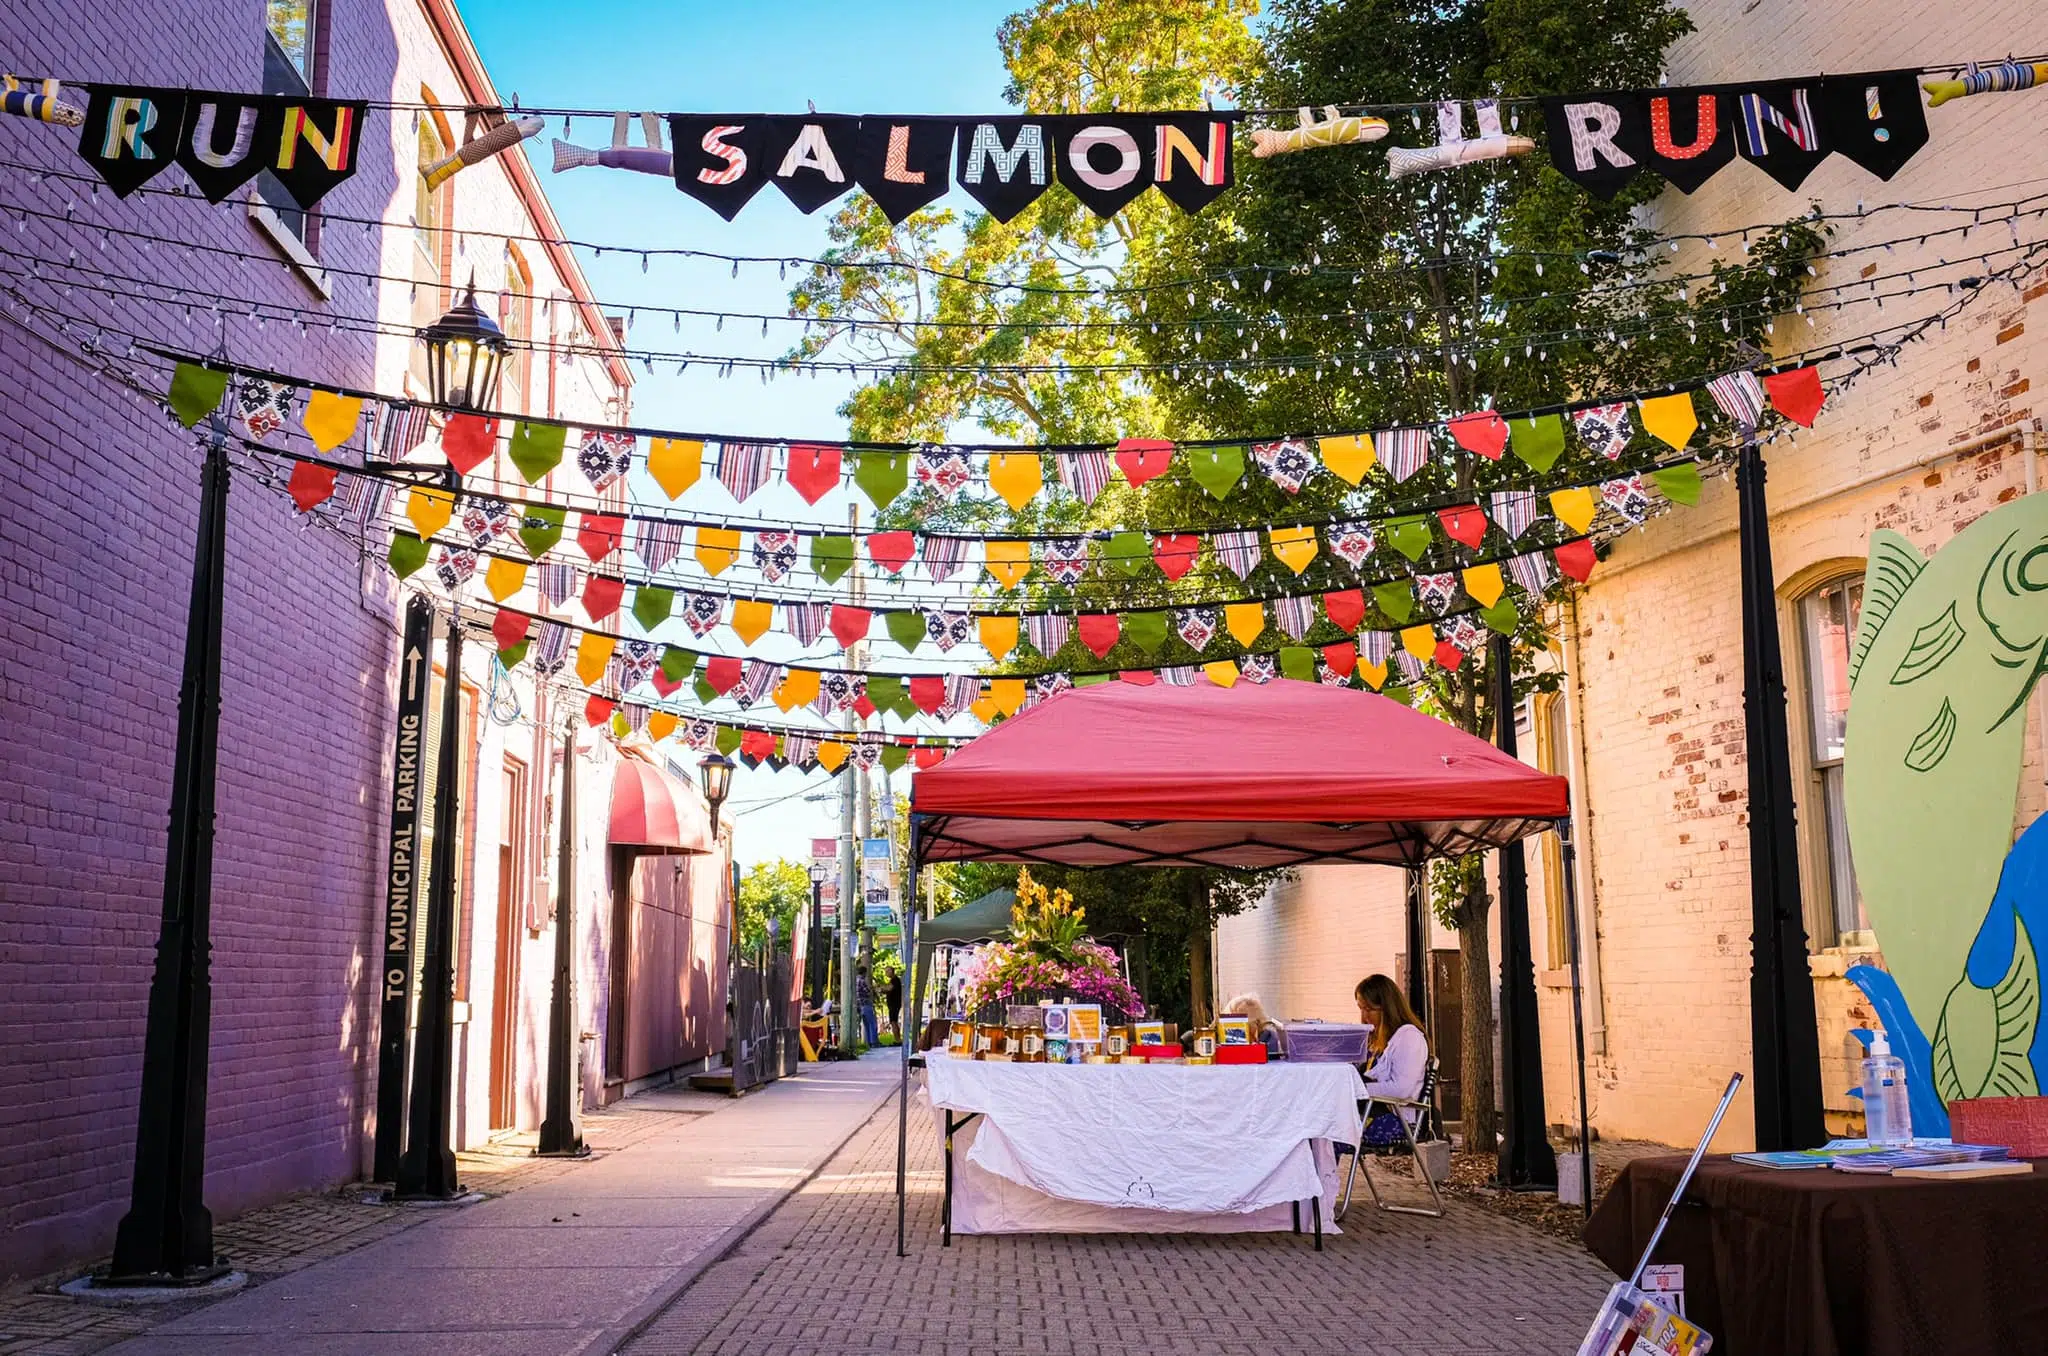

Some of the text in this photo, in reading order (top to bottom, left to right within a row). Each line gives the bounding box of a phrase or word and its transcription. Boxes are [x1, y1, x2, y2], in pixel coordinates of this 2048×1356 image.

[100, 86, 1890, 191] RUN SALMON RUN!
[386, 714, 419, 1001] TO MUNICIPAL PARKING
